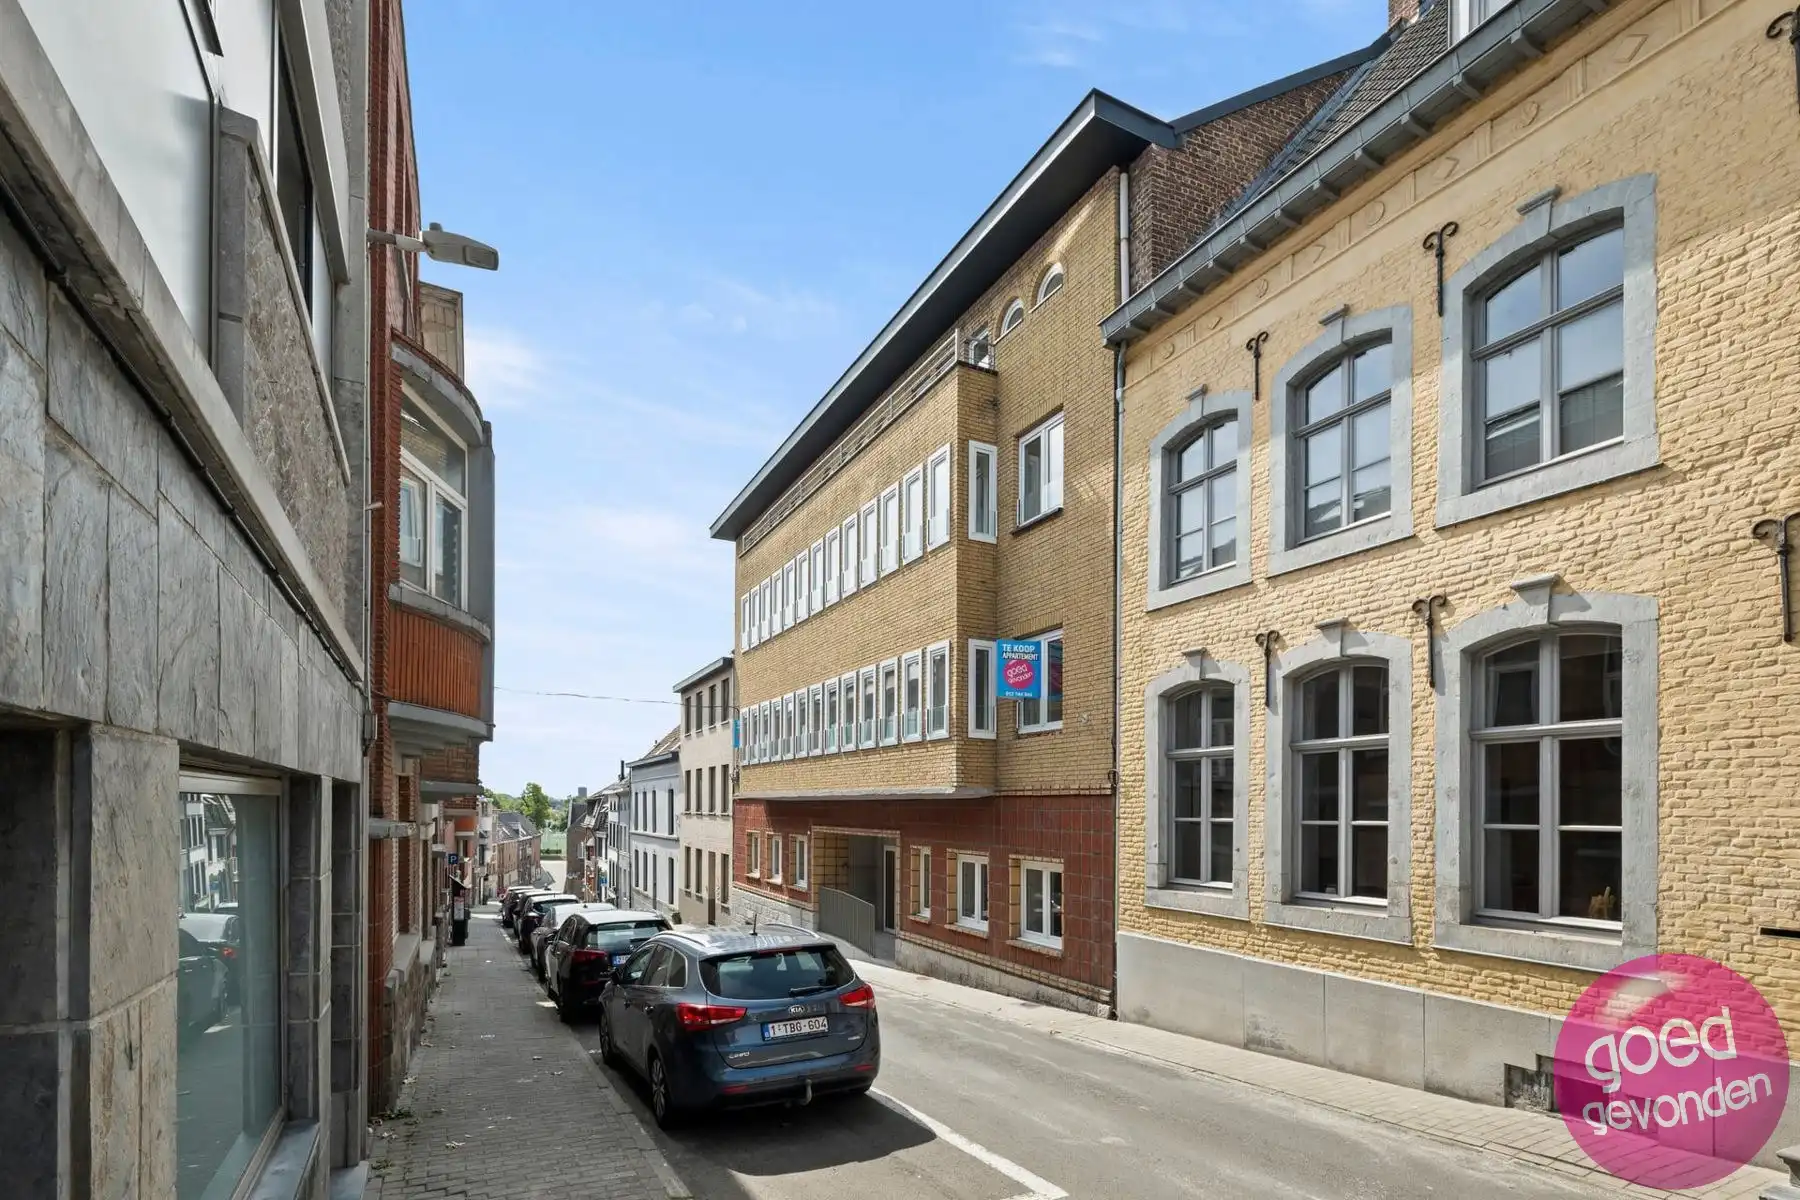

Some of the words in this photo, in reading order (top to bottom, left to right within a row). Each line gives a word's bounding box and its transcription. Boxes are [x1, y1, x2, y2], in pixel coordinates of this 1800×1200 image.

[1002, 644, 1012, 652] TE
[1013, 644, 1035, 653] KOOP
[1002, 652, 1038, 660] APPARTEMENT
[1007, 664, 1028, 678] goed
[771, 1018, 827, 1035] 1-TBG-604
